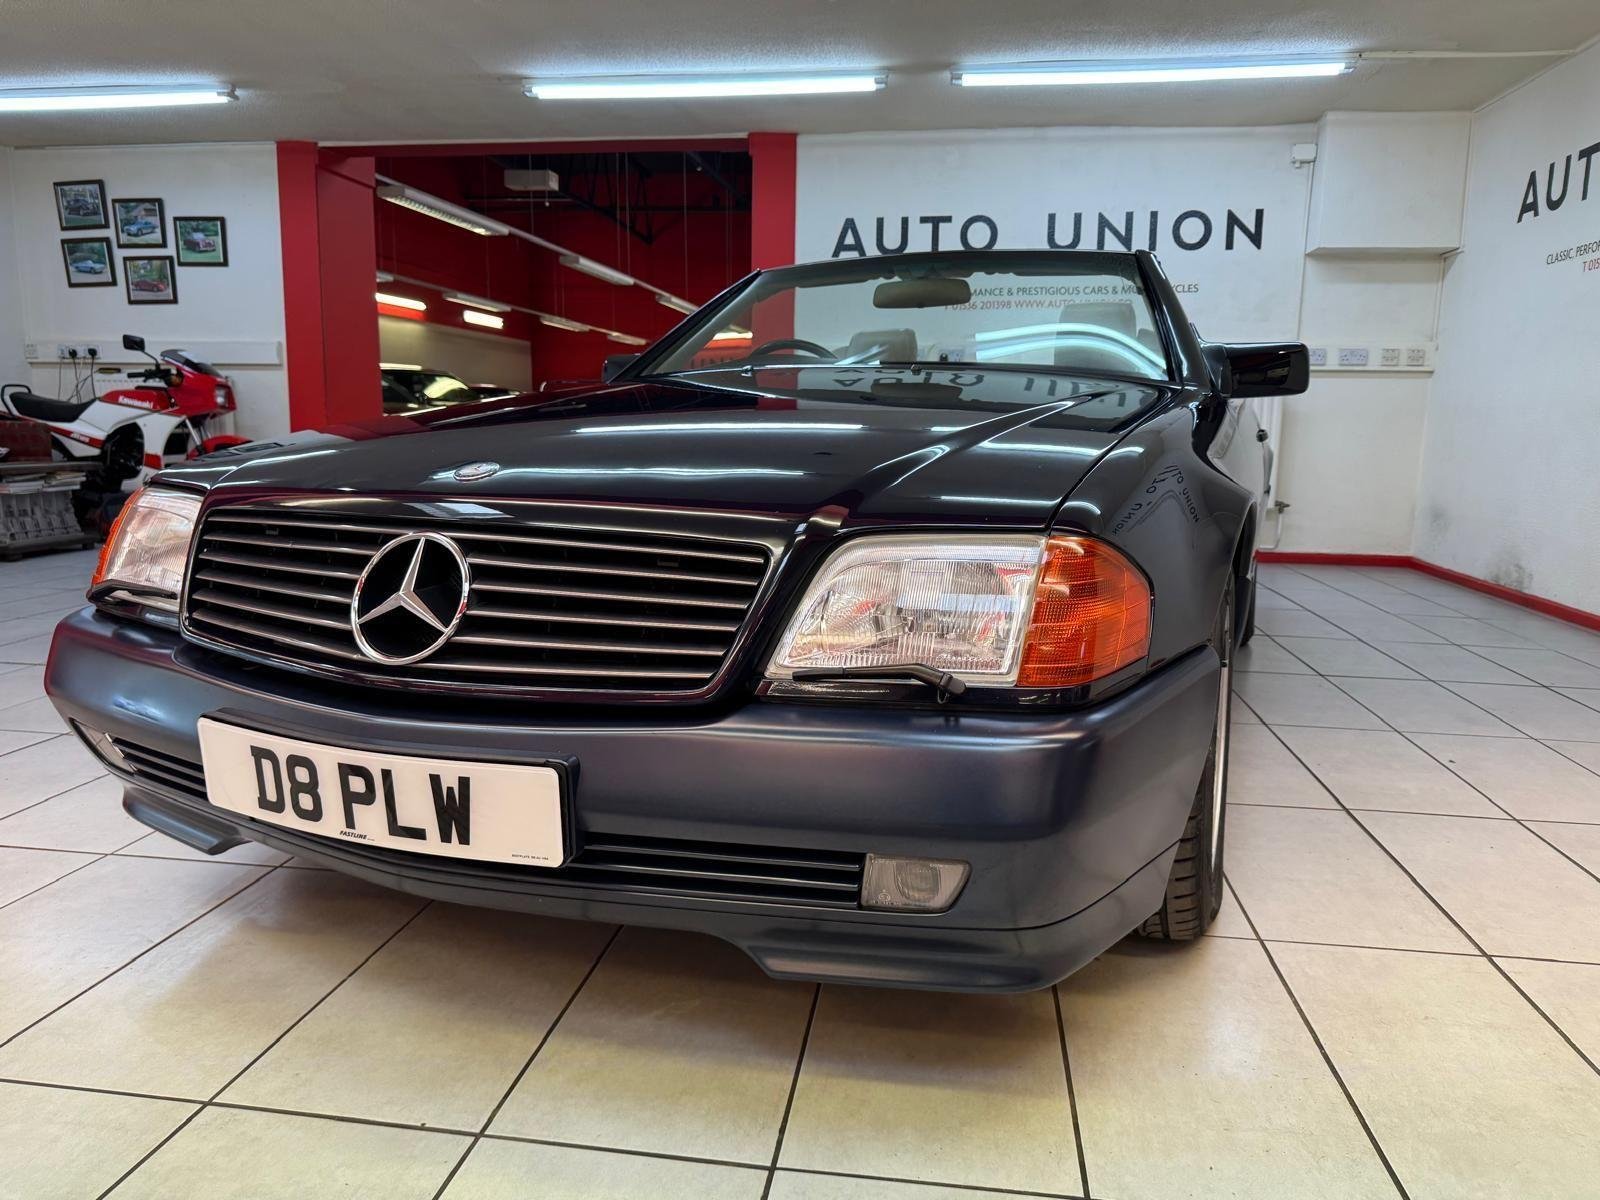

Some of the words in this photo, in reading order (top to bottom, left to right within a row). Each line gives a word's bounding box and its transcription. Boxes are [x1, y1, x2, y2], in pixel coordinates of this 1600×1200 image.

[831, 214, 998, 258] AUTO
[1047, 208, 1264, 252] UNION
[1007, 287, 1014, 296] &
[1017, 286, 1081, 296] PRESTIGIOUS
[1083, 286, 1110, 295] CARS
[1111, 286, 1118, 295] &
[980, 301, 1012, 310] 201398
[250, 744, 323, 822] D8
[337, 762, 470, 846] PLW
[340, 830, 367, 840] FASTLINE
